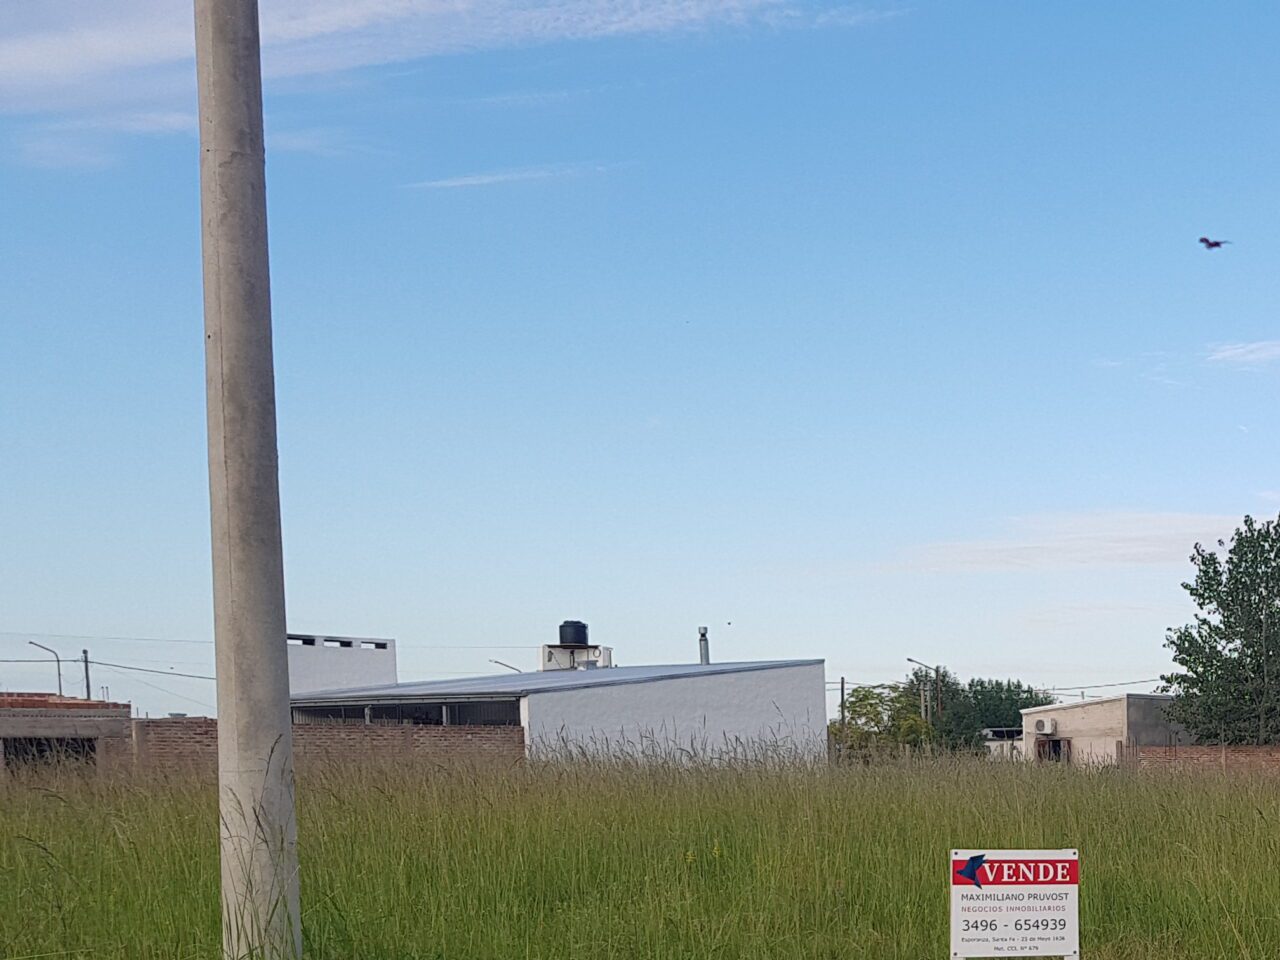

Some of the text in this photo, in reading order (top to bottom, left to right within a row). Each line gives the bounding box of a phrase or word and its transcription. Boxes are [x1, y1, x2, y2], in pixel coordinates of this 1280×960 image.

[982, 862, 1070, 882] VENDE
[961, 892, 1070, 902] MAXIMILIANO PRUVOST
[961, 904, 1066, 913] NEGOCIOS INMOBILIARIOS
[962, 919, 998, 932] 3496
[1014, 918, 1067, 931] 654939
